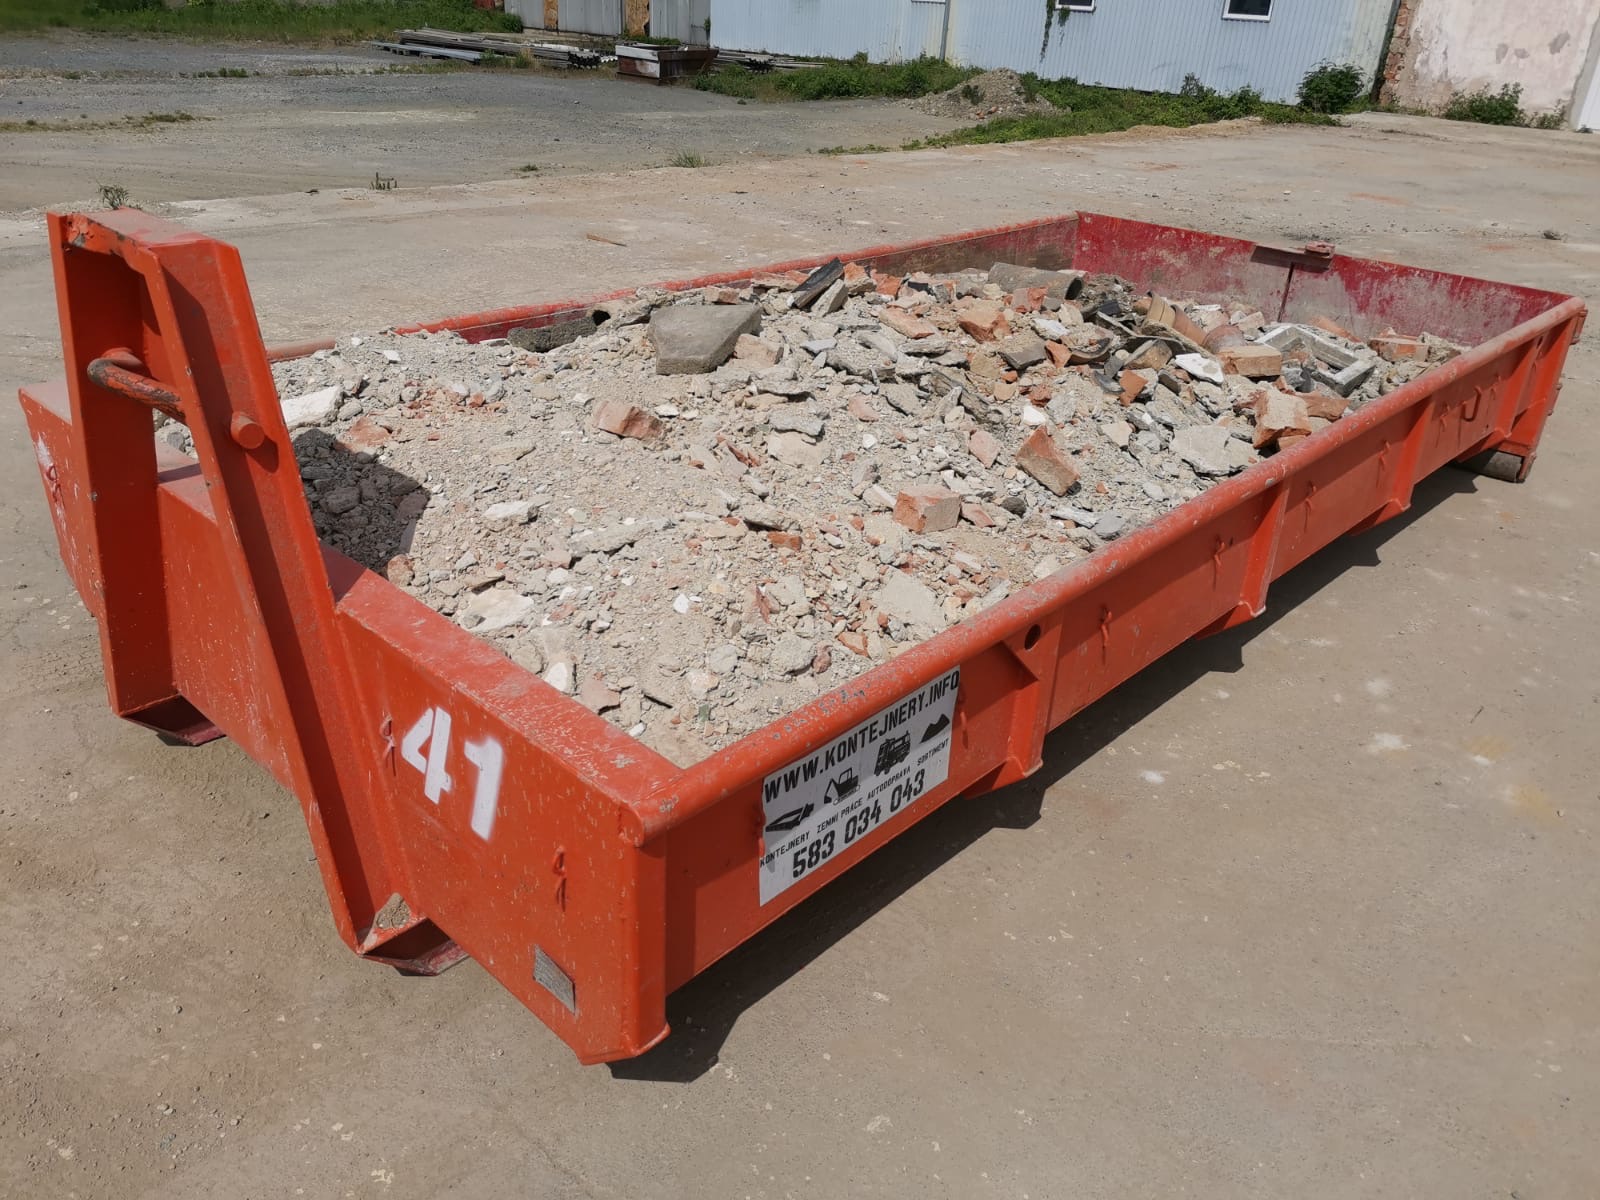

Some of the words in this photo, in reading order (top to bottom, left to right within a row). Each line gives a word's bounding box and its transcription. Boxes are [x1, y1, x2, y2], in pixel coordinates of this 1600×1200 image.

[401, 706, 503, 841] 41
[764, 670, 960, 803] WWW.KONTEJNERY.INFO
[760, 831, 810, 867] KONTEJNERY
[793, 830, 835, 878] 583
[844, 799, 882, 844] 034
[890, 768, 926, 813] 043
